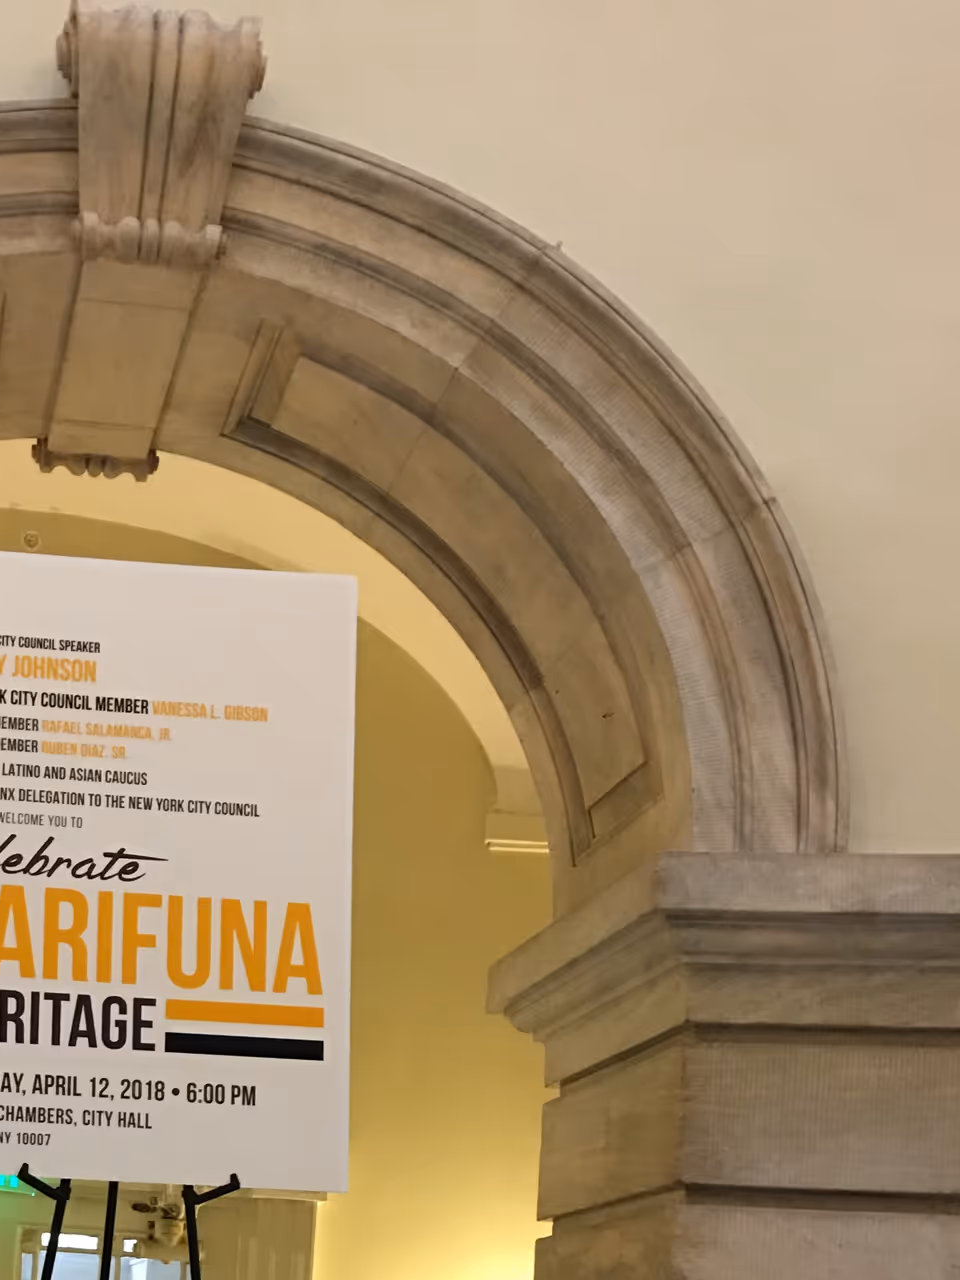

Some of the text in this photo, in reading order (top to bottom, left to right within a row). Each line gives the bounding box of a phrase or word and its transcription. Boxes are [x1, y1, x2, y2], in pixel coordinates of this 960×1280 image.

[18, 636, 57, 650] COUNCIL
[59, 640, 100, 653] SPEAKER
[12, 655, 97, 683] JOHNSON
[10, 690, 38, 706] CITY
[41, 692, 92, 710] COUNCIL
[95, 696, 148, 714] MEMBER
[152, 701, 207, 718] VANESSA
[42, 720, 82, 734] RAFAEL
[2, 762, 40, 778] LATINO
[43, 766, 66, 780] AND
[69, 768, 102, 782] ASIAN
[105, 770, 147, 785] CAUCUS
[18, 788, 85, 806] DELEGATION
[88, 793, 101, 807] TO
[105, 794, 126, 808] THE
[128, 796, 153, 810] NEW
[156, 798, 184, 812] YORK
[188, 800, 212, 814] CITY
[214, 802, 260, 817] COUNCIL
[48, 815, 67, 827] YOU
[71, 817, 82, 828] TO
[32, 1074, 82, 1096] APRIL
[90, 1077, 114, 1101] 12,
[120, 1079, 165, 1101] 2018
[187, 1082, 225, 1104] 6:00
[231, 1085, 256, 1106] PM
[82, 1110, 113, 1126] CITY
[118, 1112, 152, 1129] HALL
[16, 1132, 51, 1146] 10007
